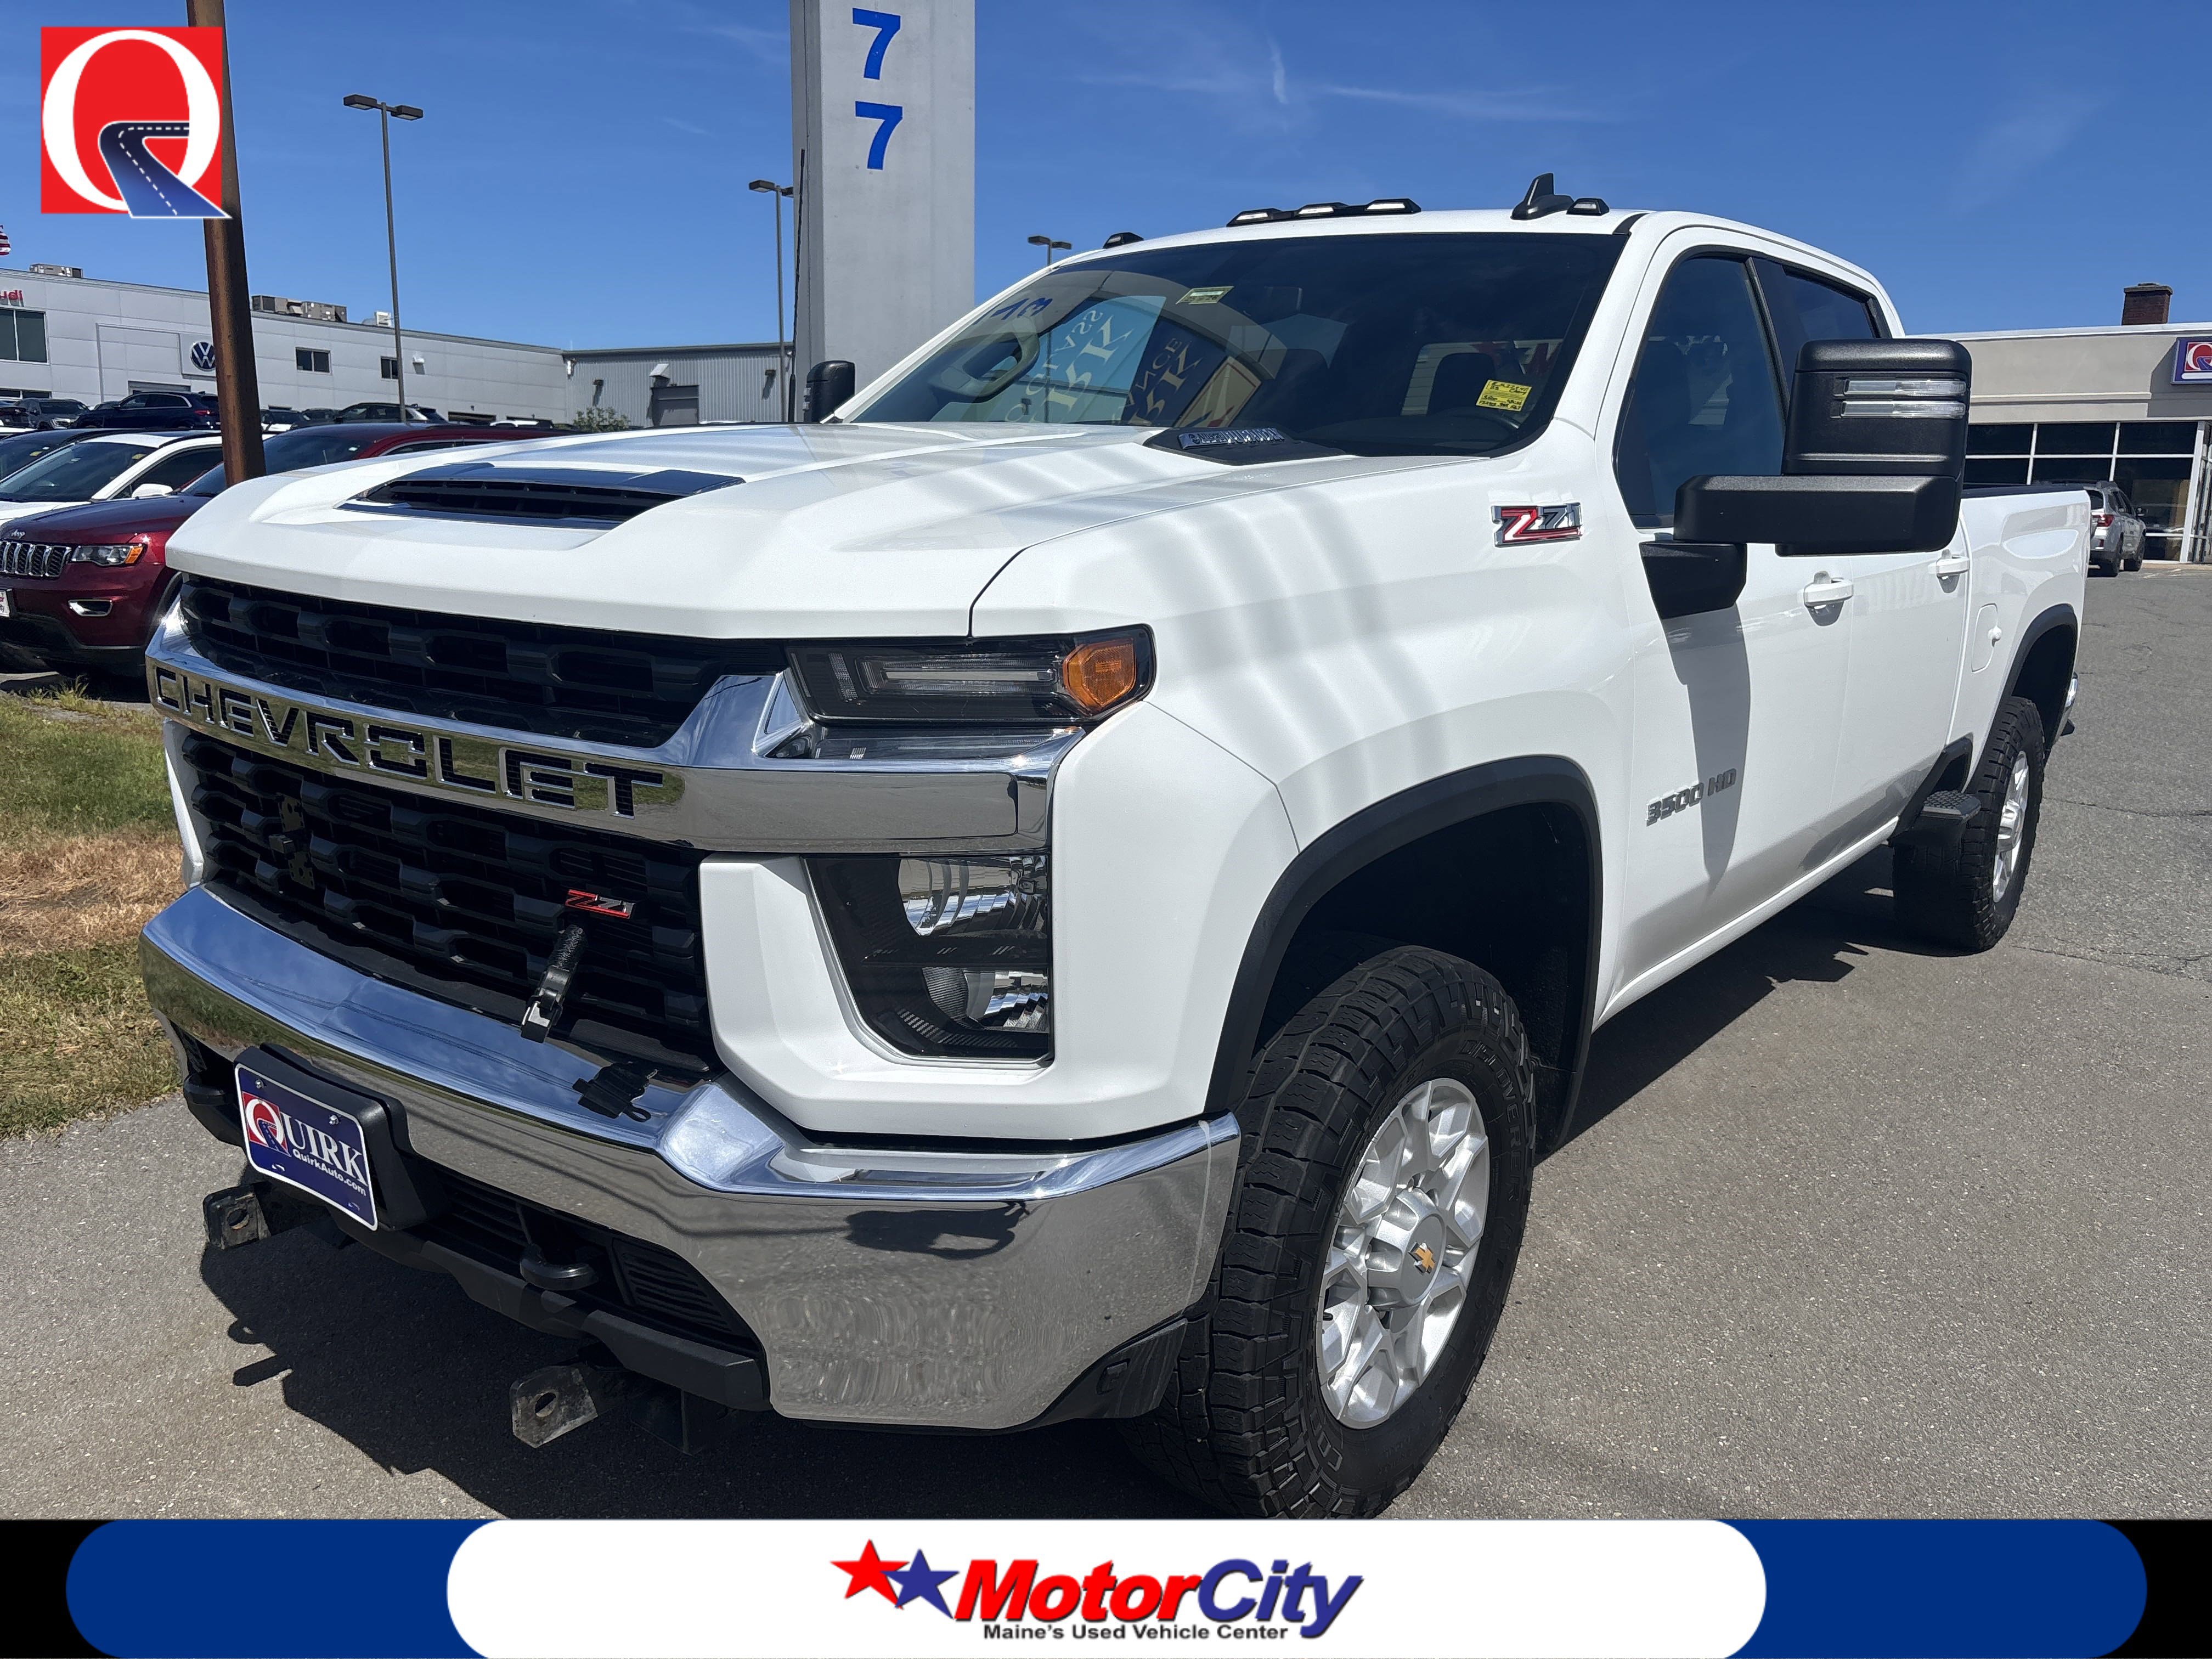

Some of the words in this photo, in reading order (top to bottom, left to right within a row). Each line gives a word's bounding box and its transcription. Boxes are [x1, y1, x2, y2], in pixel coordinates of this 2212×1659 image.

[0, 290, 23, 301] udi
[1491, 502, 1583, 548] Z71
[155, 666, 663, 820] CHEVROLET
[1646, 782, 1705, 827] 3500
[1707, 768, 1737, 796] HD
[565, 889, 636, 919] Z71
[245, 1097, 369, 1187] QUIRK
[292, 1148, 367, 1197] QuirkAuto.com
